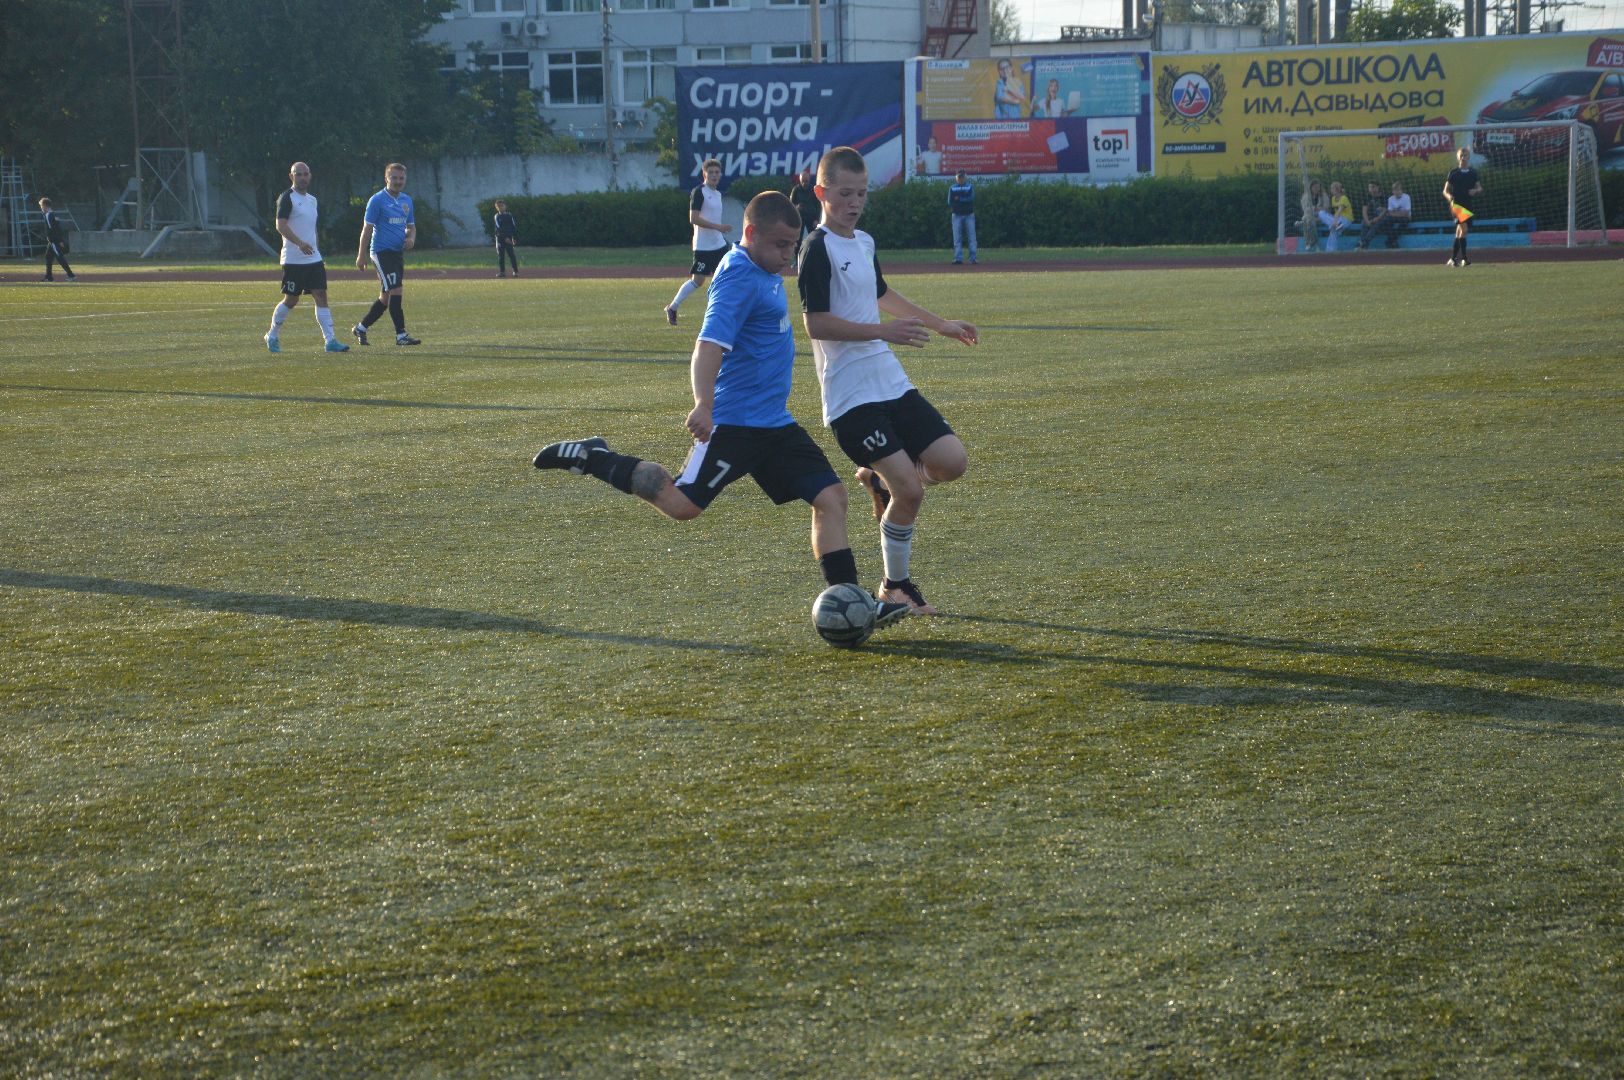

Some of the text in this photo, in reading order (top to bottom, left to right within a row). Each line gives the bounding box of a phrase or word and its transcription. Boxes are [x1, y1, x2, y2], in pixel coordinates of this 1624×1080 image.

[1242, 53, 1446, 88] АВТОШКОЛА
[690, 77, 833, 114] Спорт -
[691, 115, 818, 149] норма
[1399, 133, 1440, 151] 5000
[1093, 135, 1123, 154] top
[286, 281, 296, 293] 13
[386, 272, 397, 285] 17
[707, 459, 732, 489] 7
